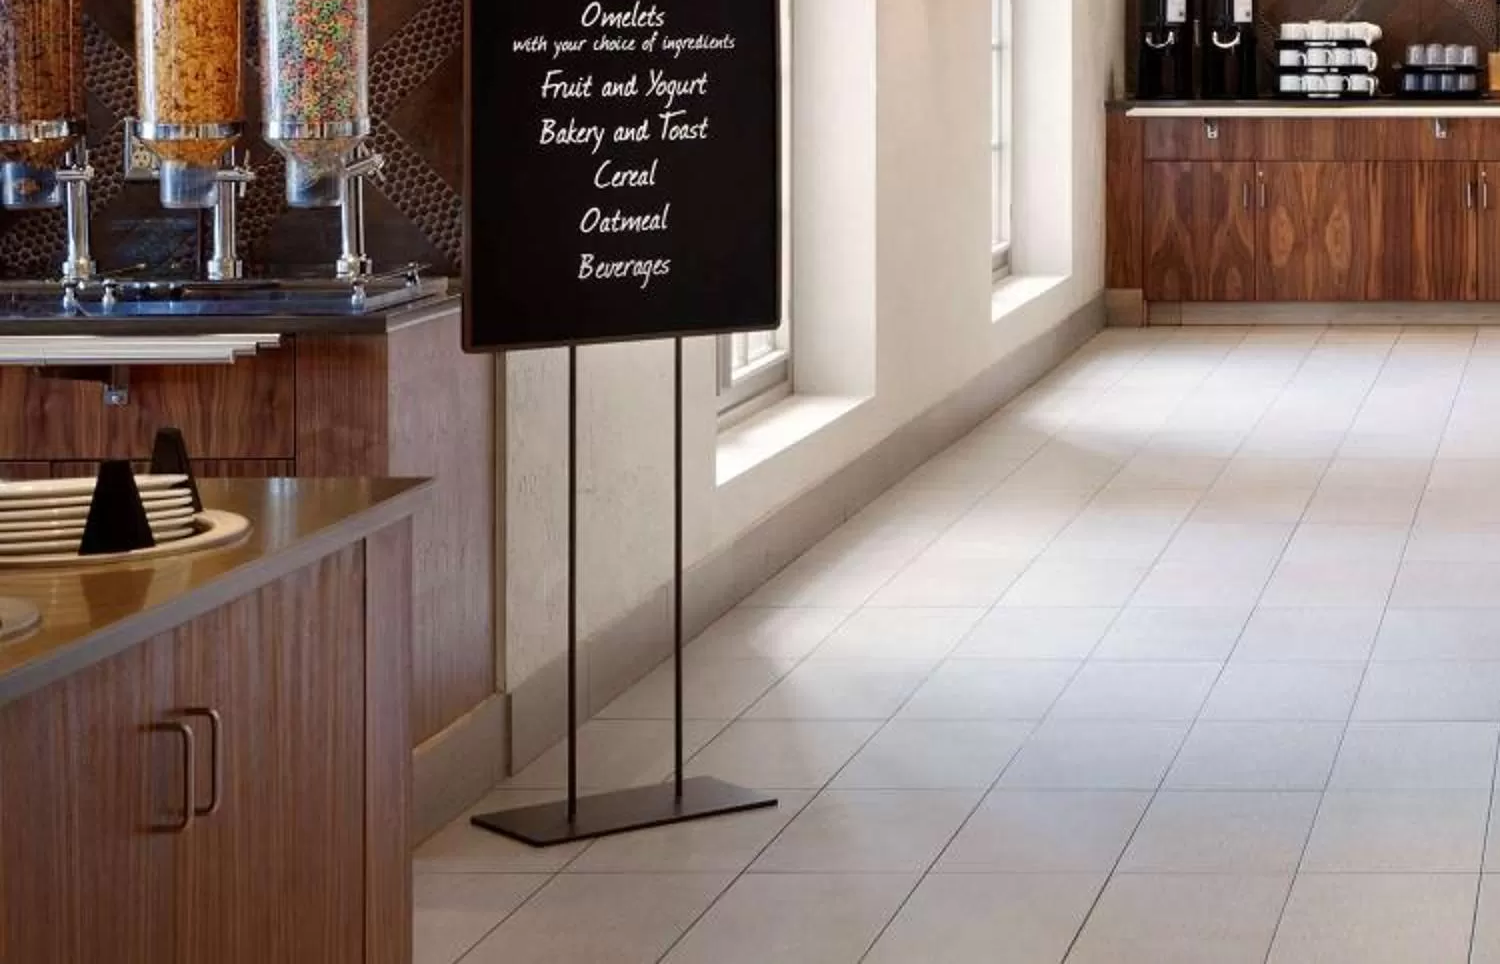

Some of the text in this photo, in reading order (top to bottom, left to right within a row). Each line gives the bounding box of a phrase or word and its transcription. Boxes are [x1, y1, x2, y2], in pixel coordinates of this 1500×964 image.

[580, 1, 666, 29] Omelets
[512, 31, 737, 60] with your choice of ingredients
[541, 68, 708, 108] Fruit and Yogurt
[539, 110, 709, 154] Bakery and Toast
[593, 158, 659, 189] Cereal
[579, 204, 670, 234] Oatmeal
[577, 254, 671, 289] Beverages
